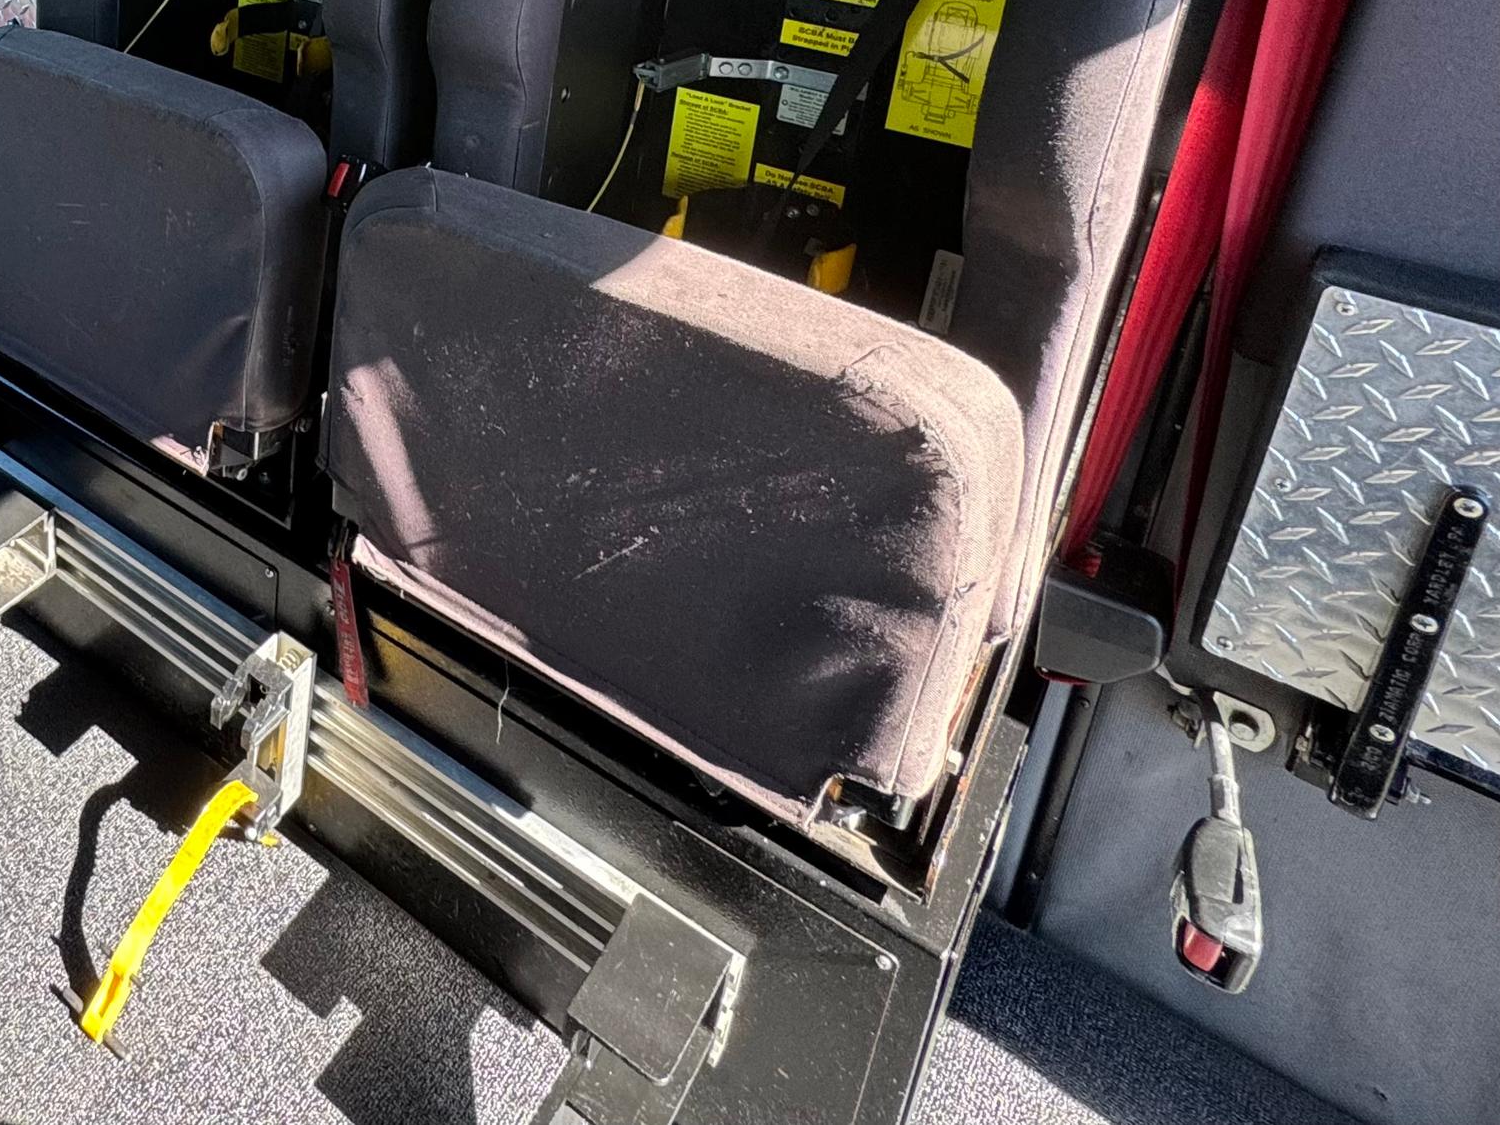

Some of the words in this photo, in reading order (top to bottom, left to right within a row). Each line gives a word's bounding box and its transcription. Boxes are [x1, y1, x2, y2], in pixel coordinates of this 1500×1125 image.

[798, 27, 823, 37] SCBA
[826, 32, 846, 42] Must
[792, 35, 829, 48] Strapped
[923, 127, 952, 139] SHOWN
